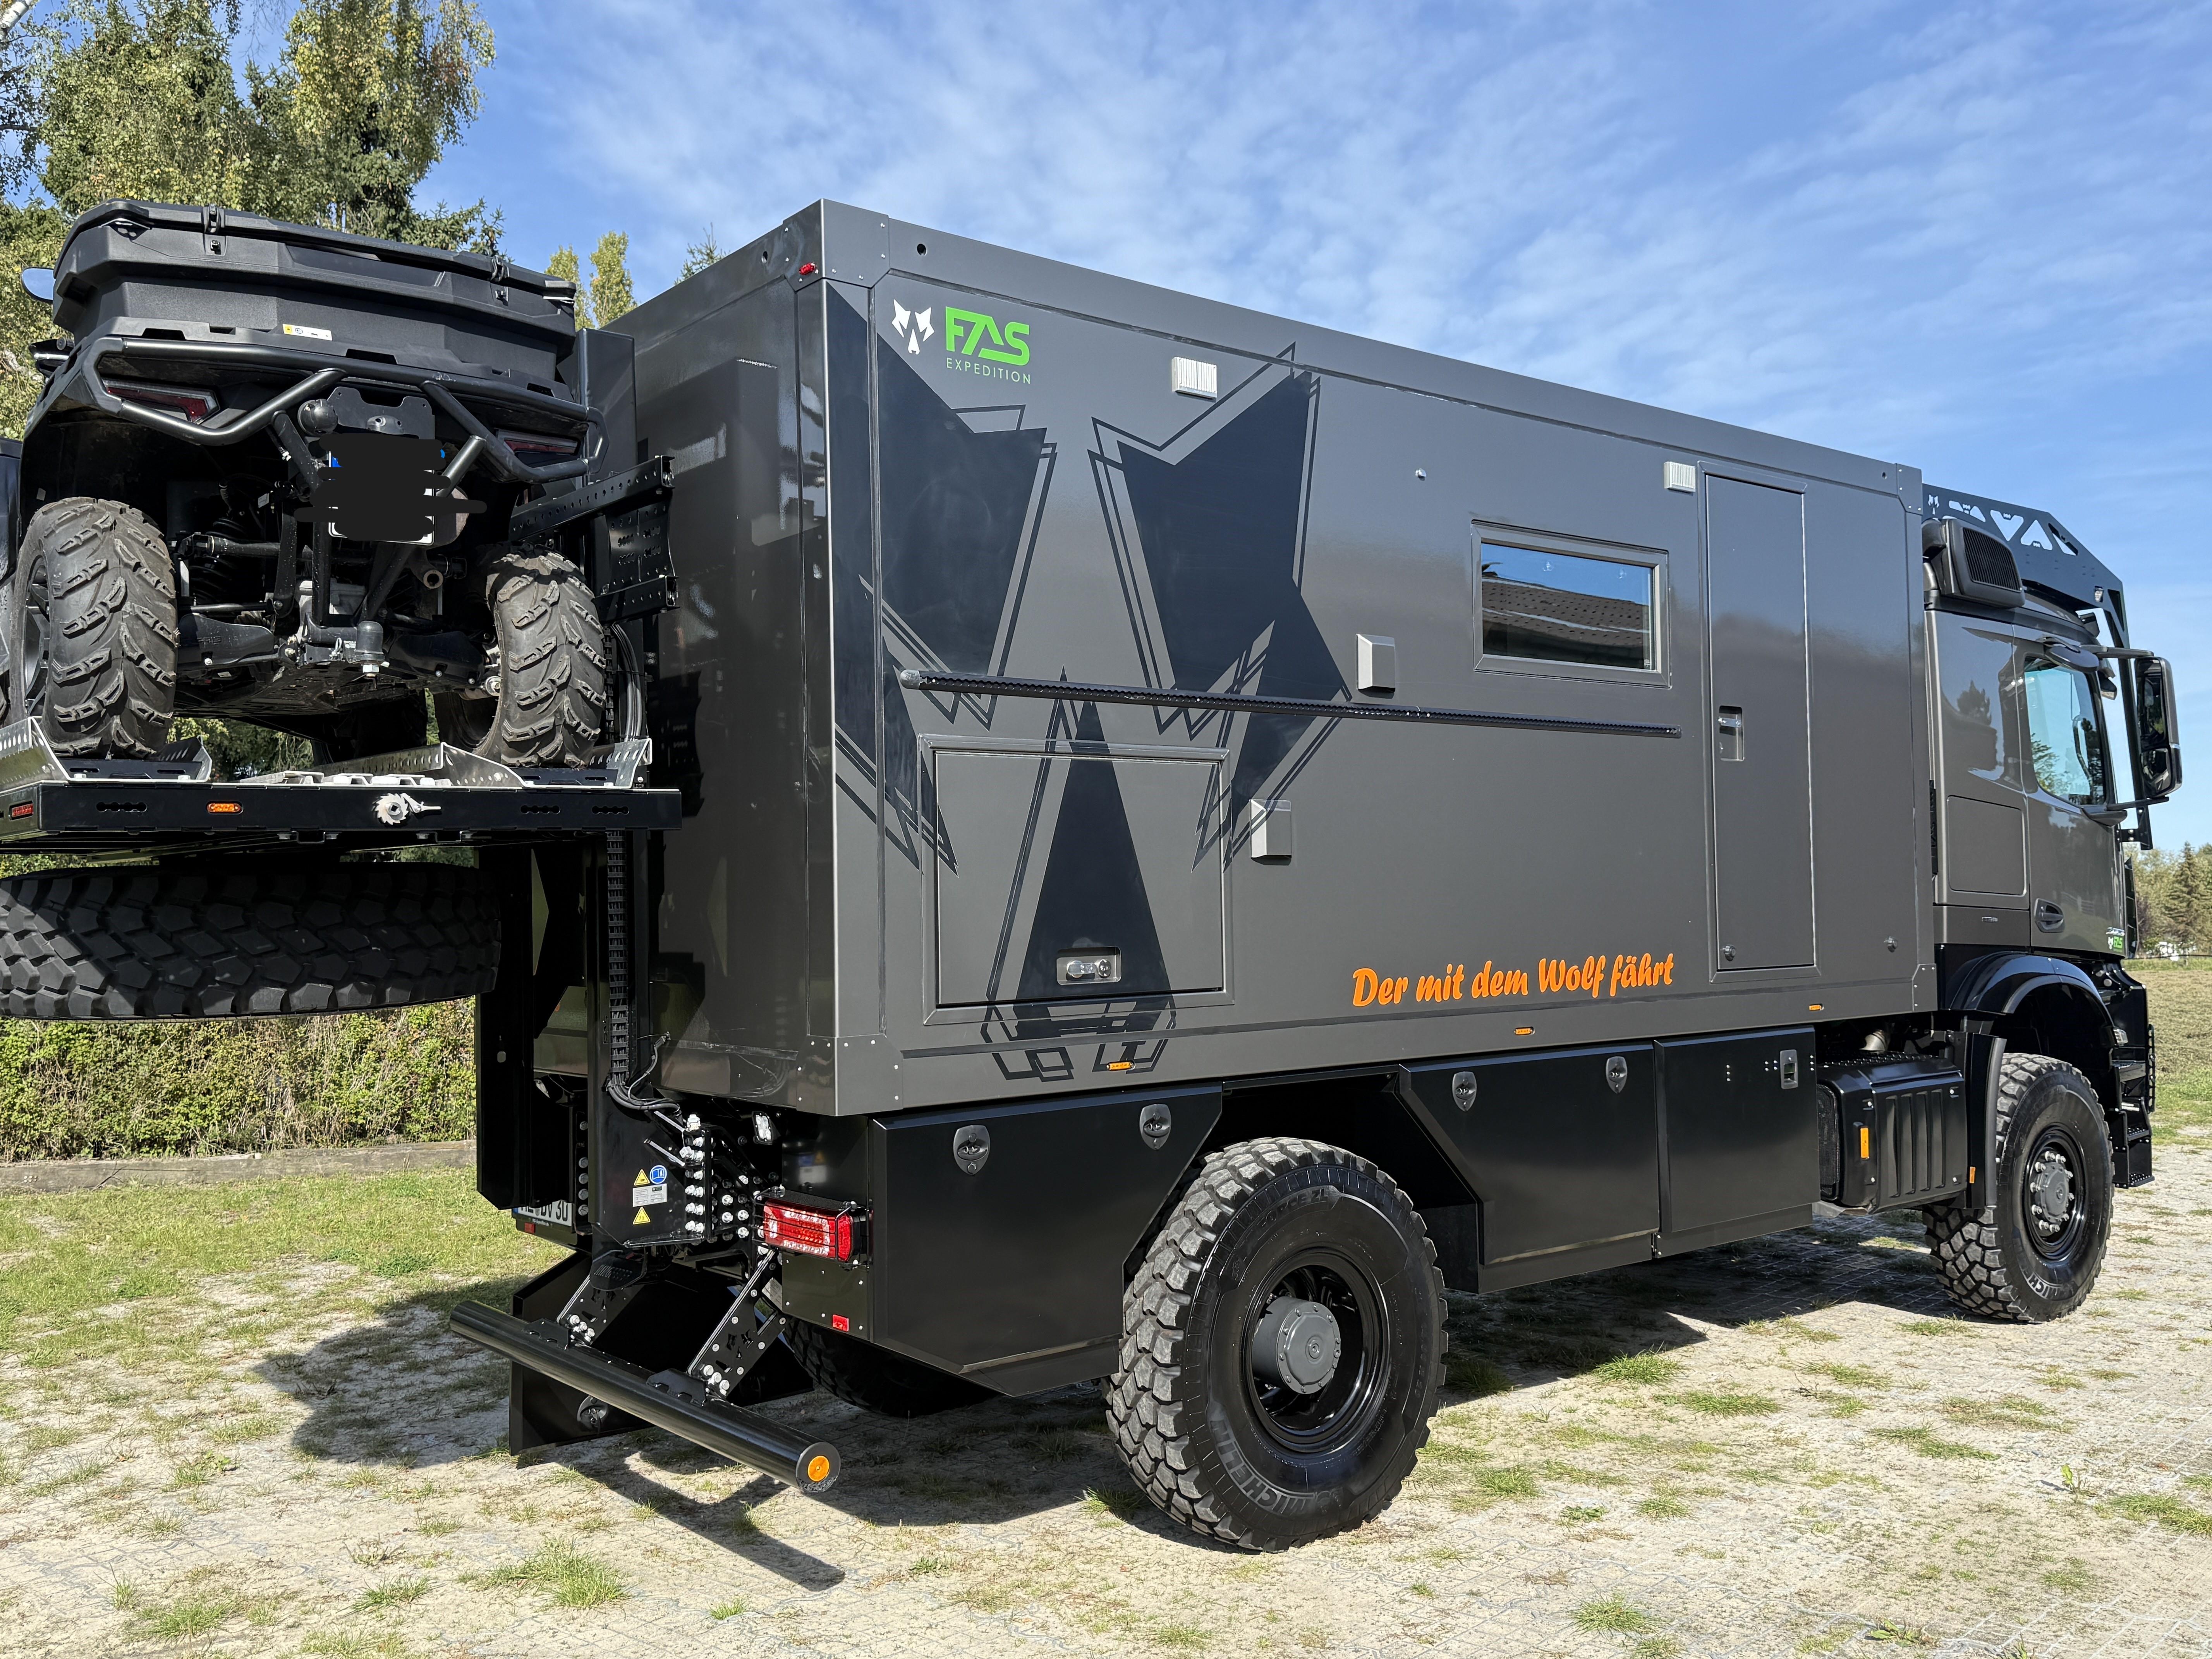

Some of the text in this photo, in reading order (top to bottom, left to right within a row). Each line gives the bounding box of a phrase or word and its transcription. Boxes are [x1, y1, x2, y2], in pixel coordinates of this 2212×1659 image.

[945, 306, 1030, 366] FAS
[946, 357, 1031, 384] EXPEDITION
[1353, 953, 1674, 1007] Der mit dem Wolf fährt
[1210, 1420, 1313, 1515] MICHELIN
